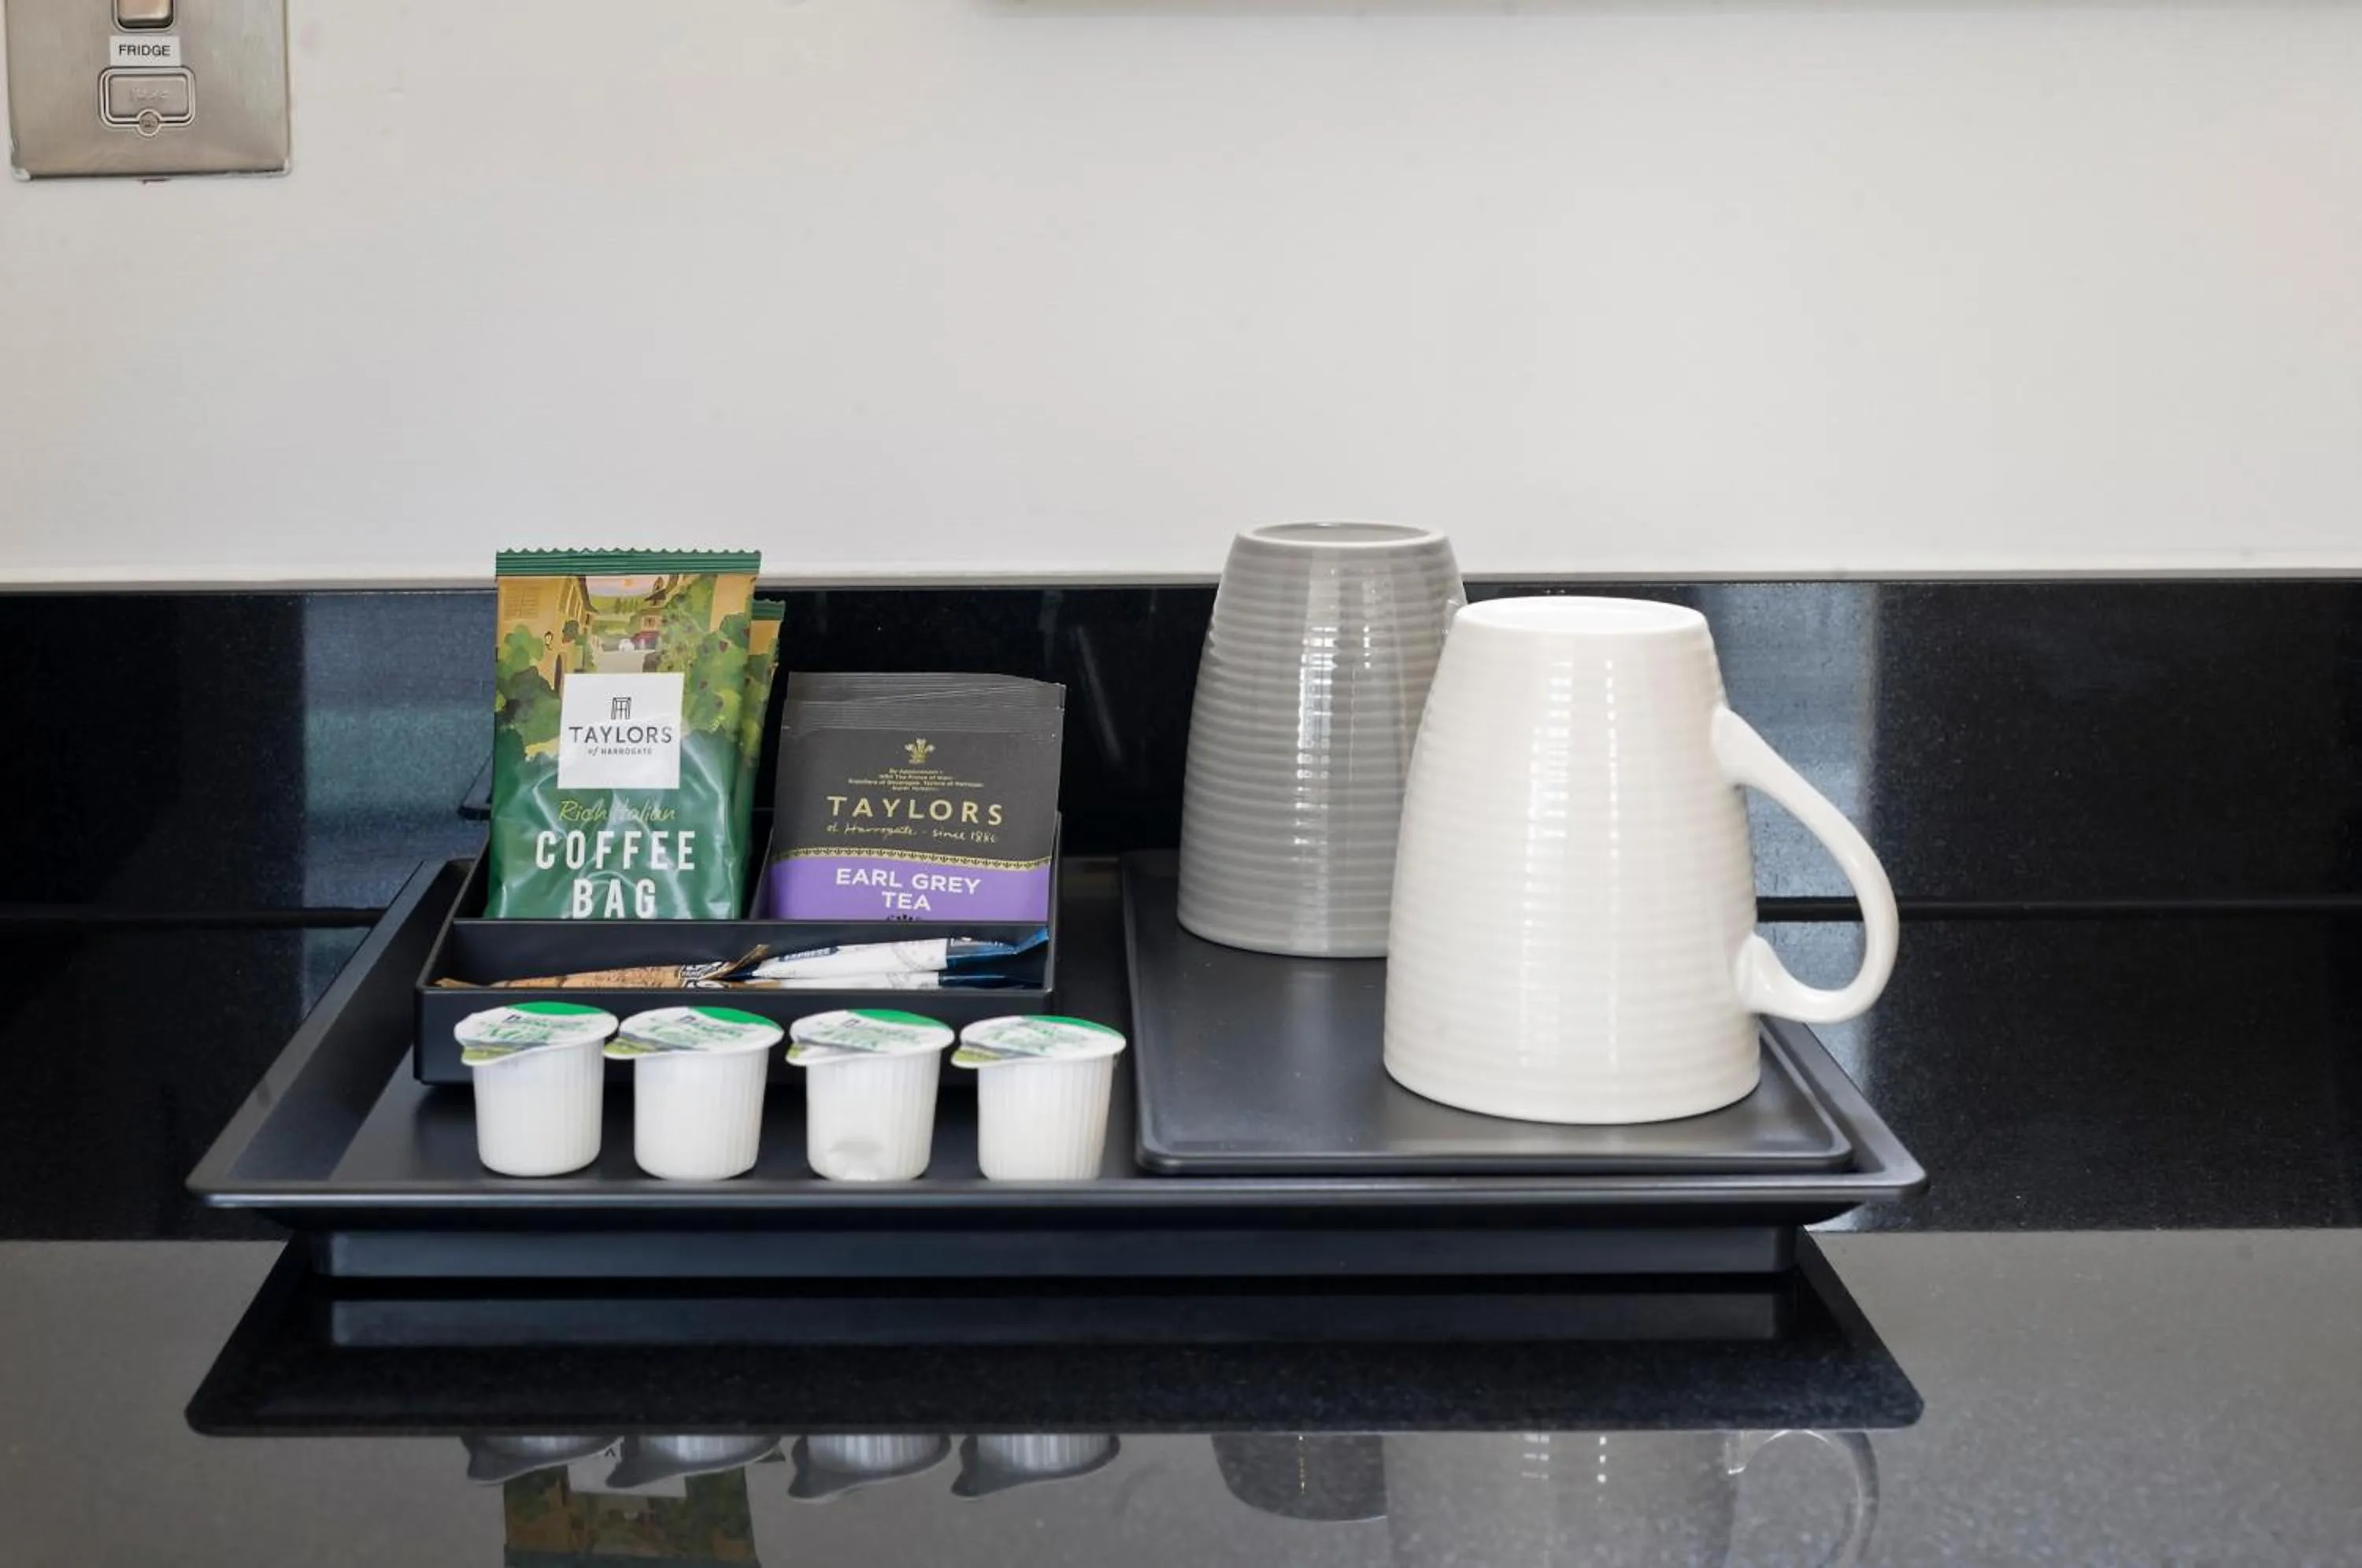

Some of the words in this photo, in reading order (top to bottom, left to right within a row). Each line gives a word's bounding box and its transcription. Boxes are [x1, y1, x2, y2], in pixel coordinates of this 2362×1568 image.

[118, 44, 171, 56] FRIDGE
[568, 726, 672, 744] TAYLORS
[557, 797, 607, 822] Rich
[827, 796, 1003, 826] TAYLORS
[535, 830, 696, 870] COFFEE
[836, 868, 903, 889] EARL
[911, 873, 982, 896] GREY
[572, 878, 657, 919] BAG
[881, 891, 932, 912] TEA
